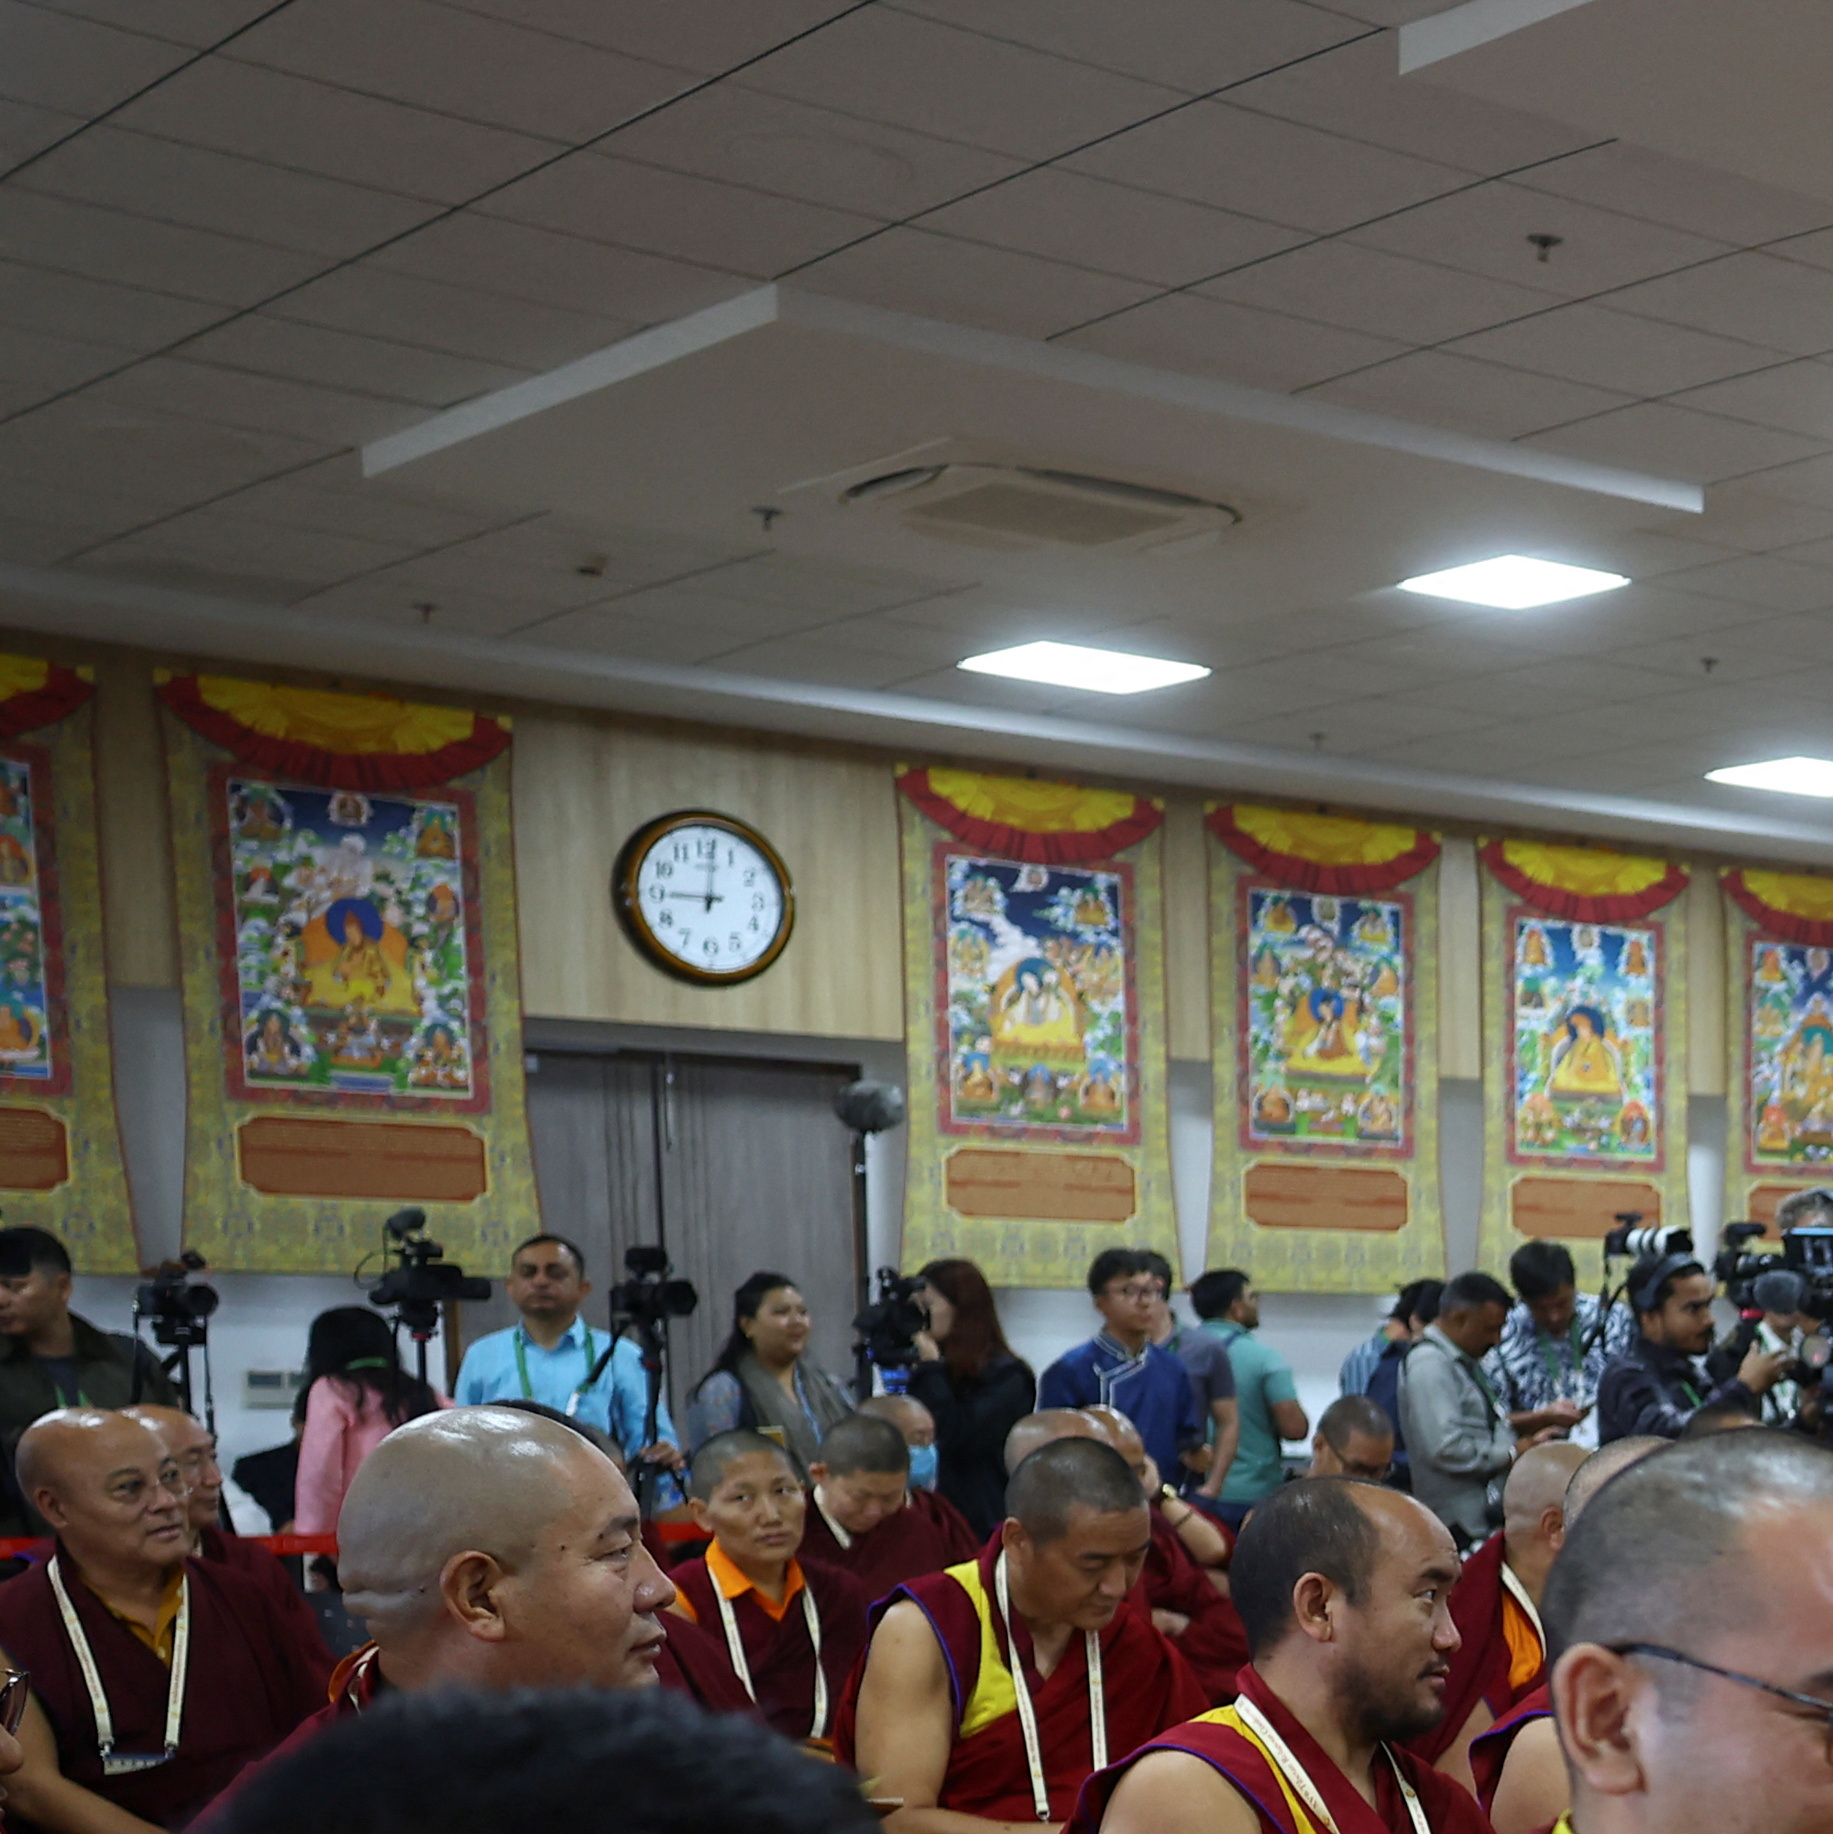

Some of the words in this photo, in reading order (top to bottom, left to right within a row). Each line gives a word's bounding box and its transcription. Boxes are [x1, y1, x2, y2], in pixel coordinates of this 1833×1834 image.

[674, 842, 689, 862] 11
[727, 848, 734, 868] 1
[656, 861, 674, 878] 10
[743, 867, 756, 887] 2
[649, 883, 666, 903] 9
[751, 892, 765, 912] 3
[659, 908, 674, 928] 8
[748, 915, 759, 935] 4
[678, 927, 691, 948] 7
[703, 936, 719, 956] 6
[728, 931, 741, 952] 5
